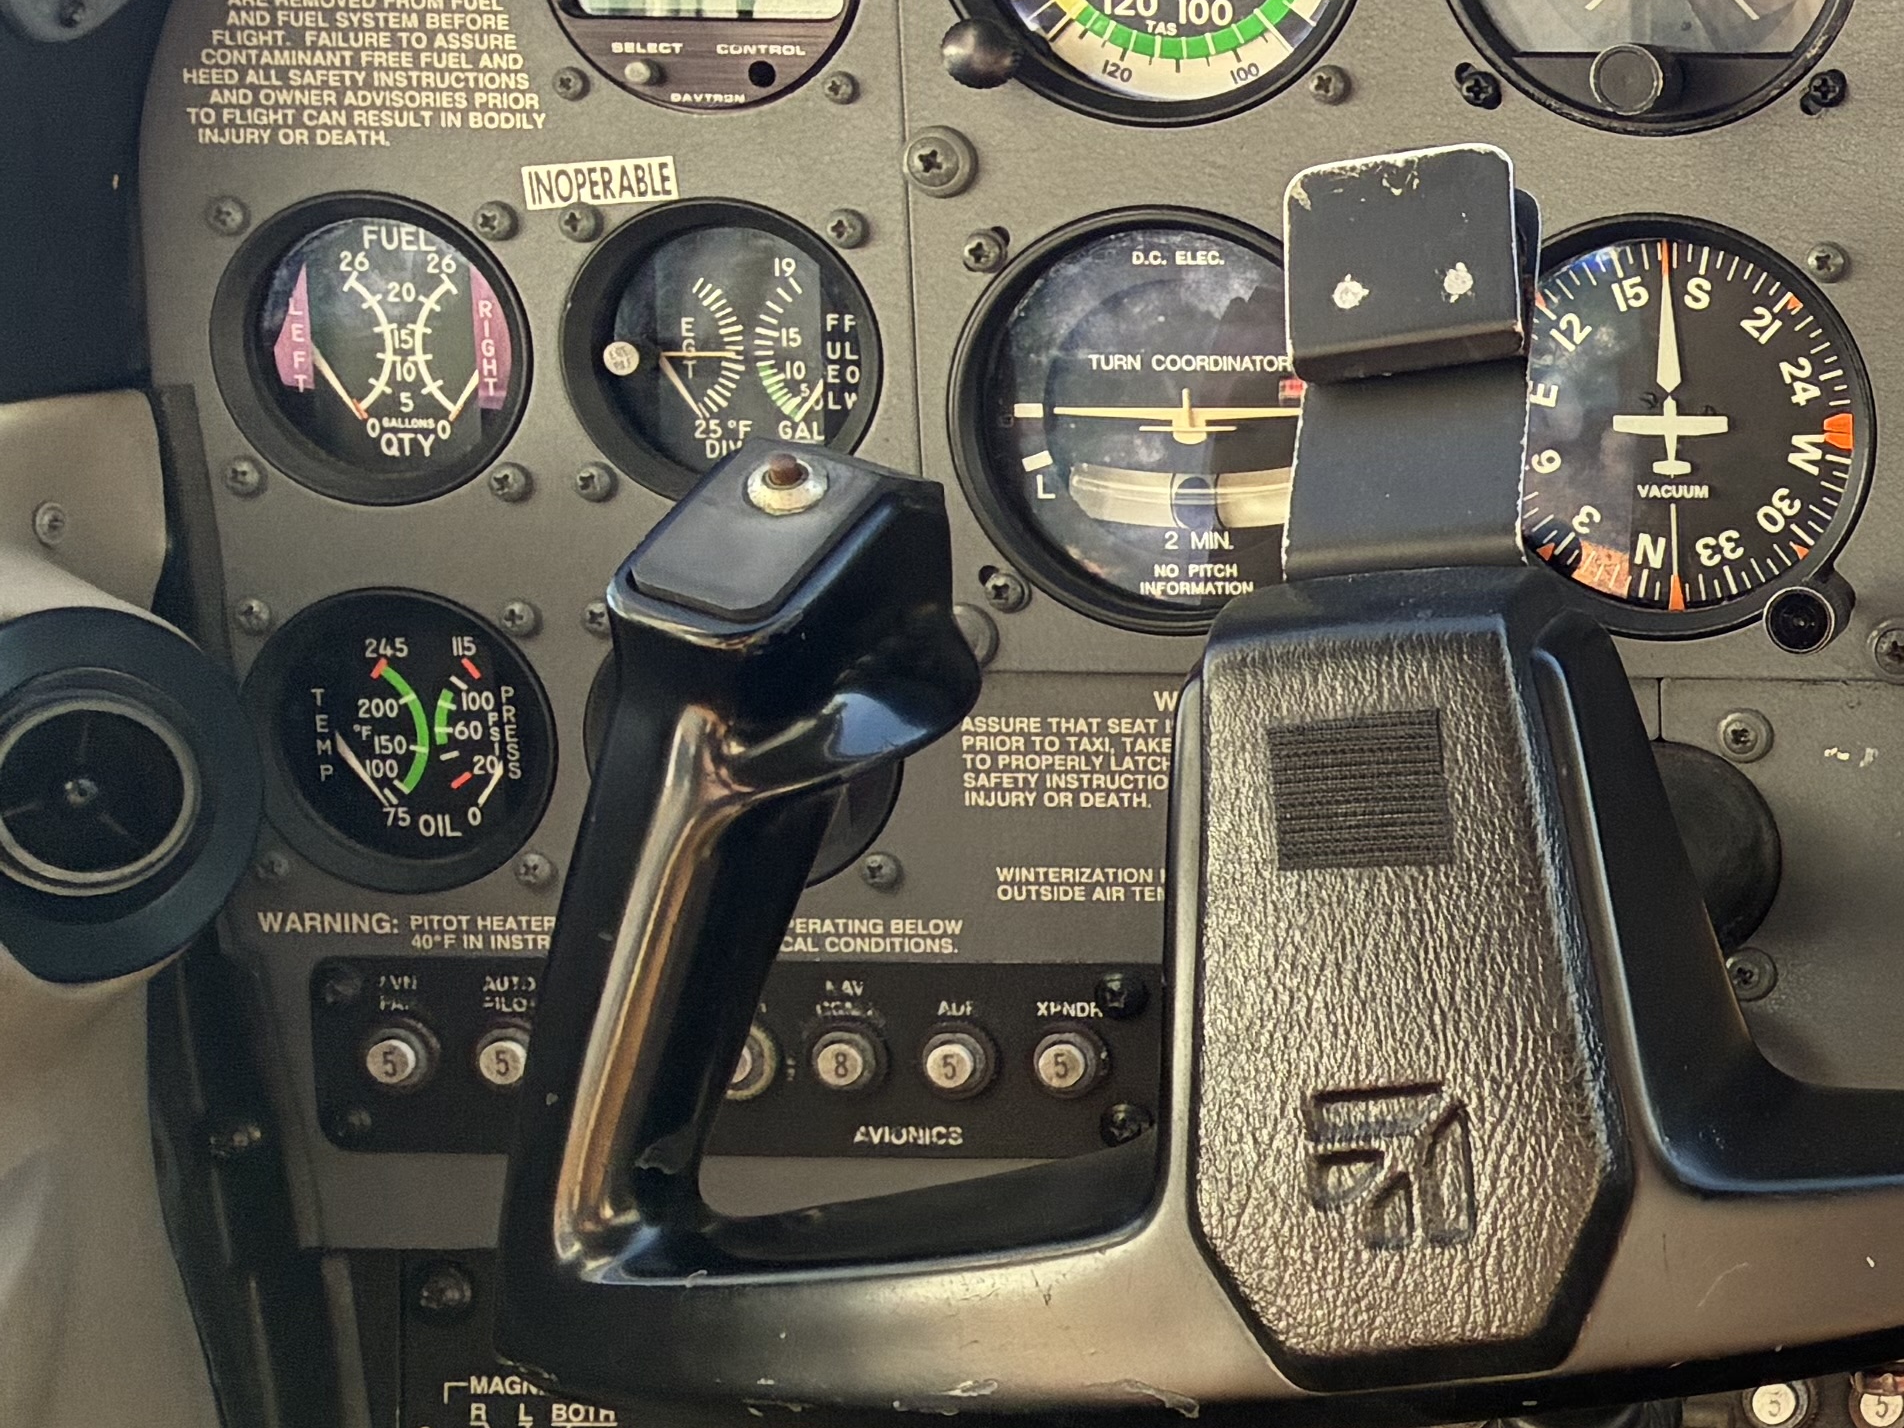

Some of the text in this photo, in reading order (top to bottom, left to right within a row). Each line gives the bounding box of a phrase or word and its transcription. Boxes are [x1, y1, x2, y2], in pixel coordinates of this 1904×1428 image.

[227, 10, 511, 32] AND FUEL SYSTEM BEFORE
[610, 41, 684, 55] SELECT
[186, 107, 547, 130] TO FLIGHT CAN RESULT IN BODILY
[528, 164, 674, 205] INOPERABLE
[362, 225, 438, 252] FUEL
[339, 251, 370, 272] 26
[426, 252, 457, 274] 26
[1131, 250, 1226, 266] D.C. ELEC.
[1086, 352, 1293, 373] TURN COORDINATOR
[380, 431, 435, 458] QTY
[1636, 483, 1709, 499] VACUUM
[1164, 530, 1234, 550] 2 MIN.
[1153, 563, 1238, 579] NO PITCH
[1139, 580, 1254, 597] INFORMATION
[961, 734, 1115, 755] PRIOR TO TAXI,
[964, 790, 1152, 809] INJURY OR DEATH.
[418, 813, 463, 838] OIL
[853, 1125, 964, 1146] AVIONICS
